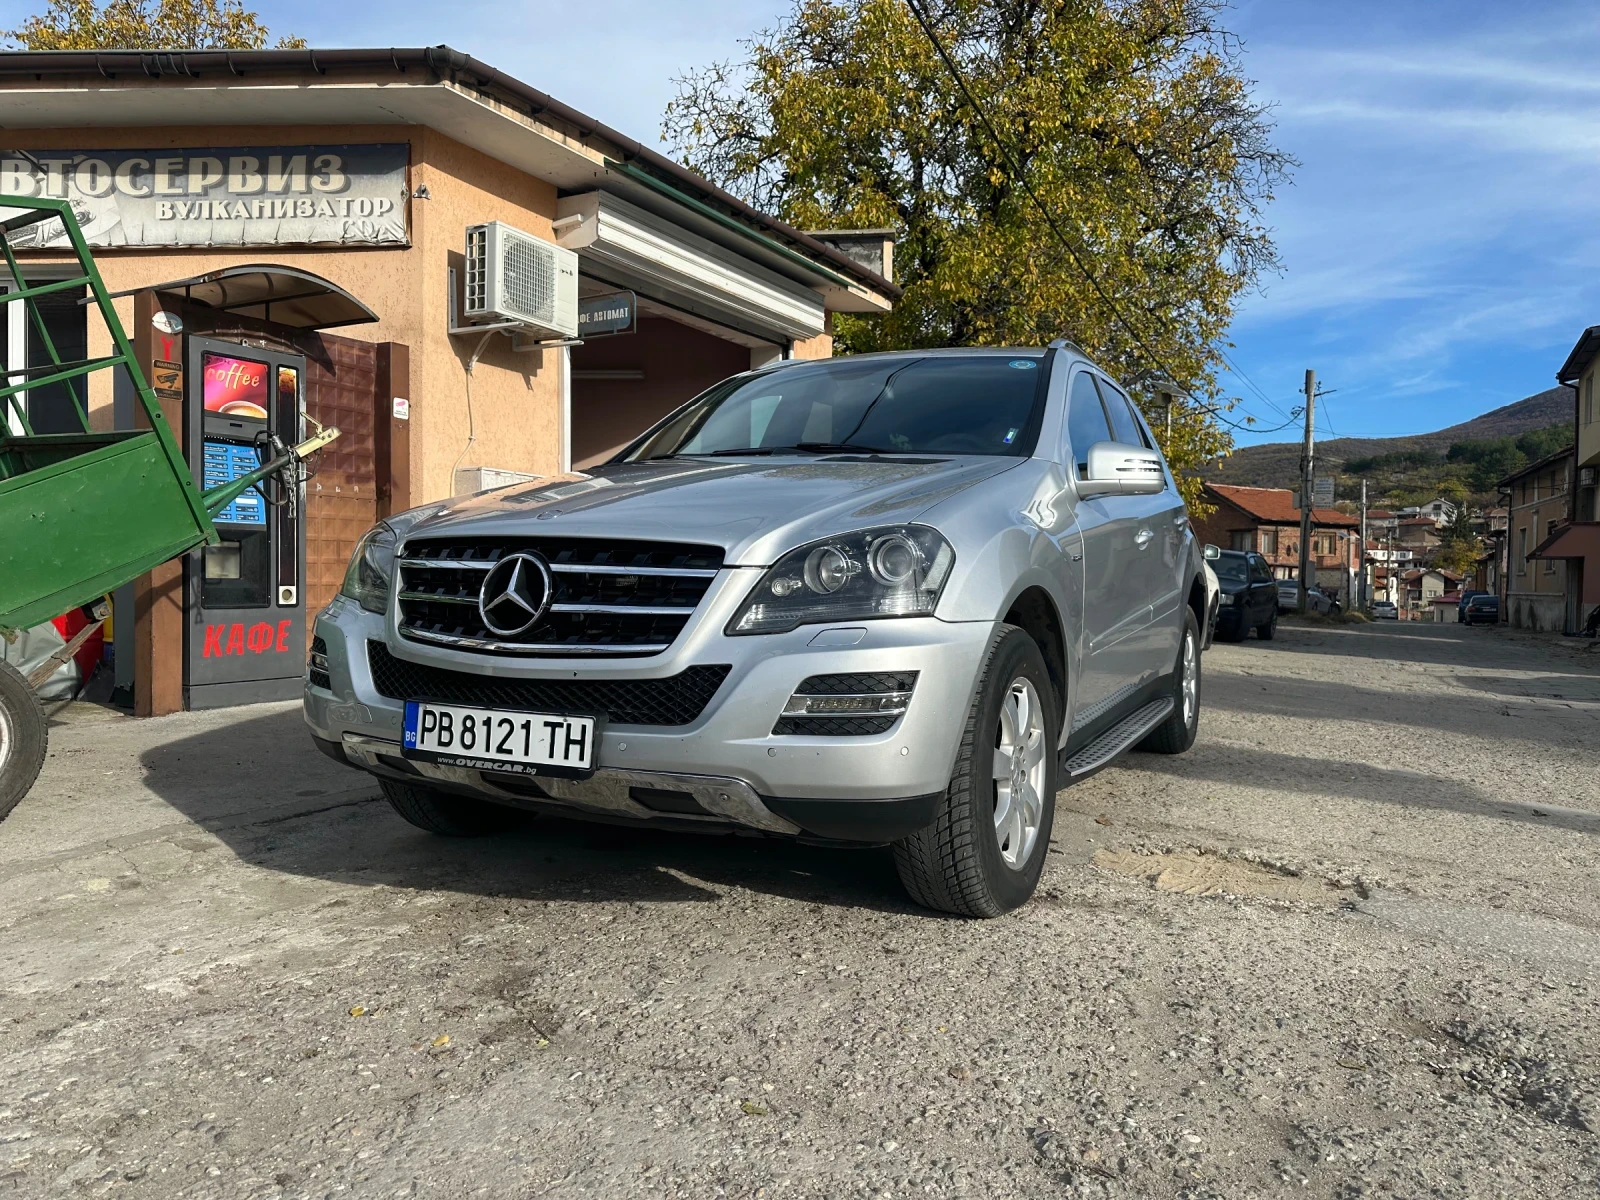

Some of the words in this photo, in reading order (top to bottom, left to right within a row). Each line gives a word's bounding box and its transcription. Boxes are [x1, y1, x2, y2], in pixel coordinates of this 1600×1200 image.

[155, 197, 393, 221] ВУЛКАНИЗАТОР
[578, 313, 591, 324] ФЕ
[593, 307, 629, 322] АВТОМАТ
[206, 363, 260, 390] coffee
[202, 619, 292, 658] КАФЕ
[405, 731, 416, 743] BG
[420, 709, 453, 747] PB
[461, 714, 531, 757] 8121
[543, 721, 587, 762] TH
[437, 757, 537, 775] www.OVERCAR.bg
